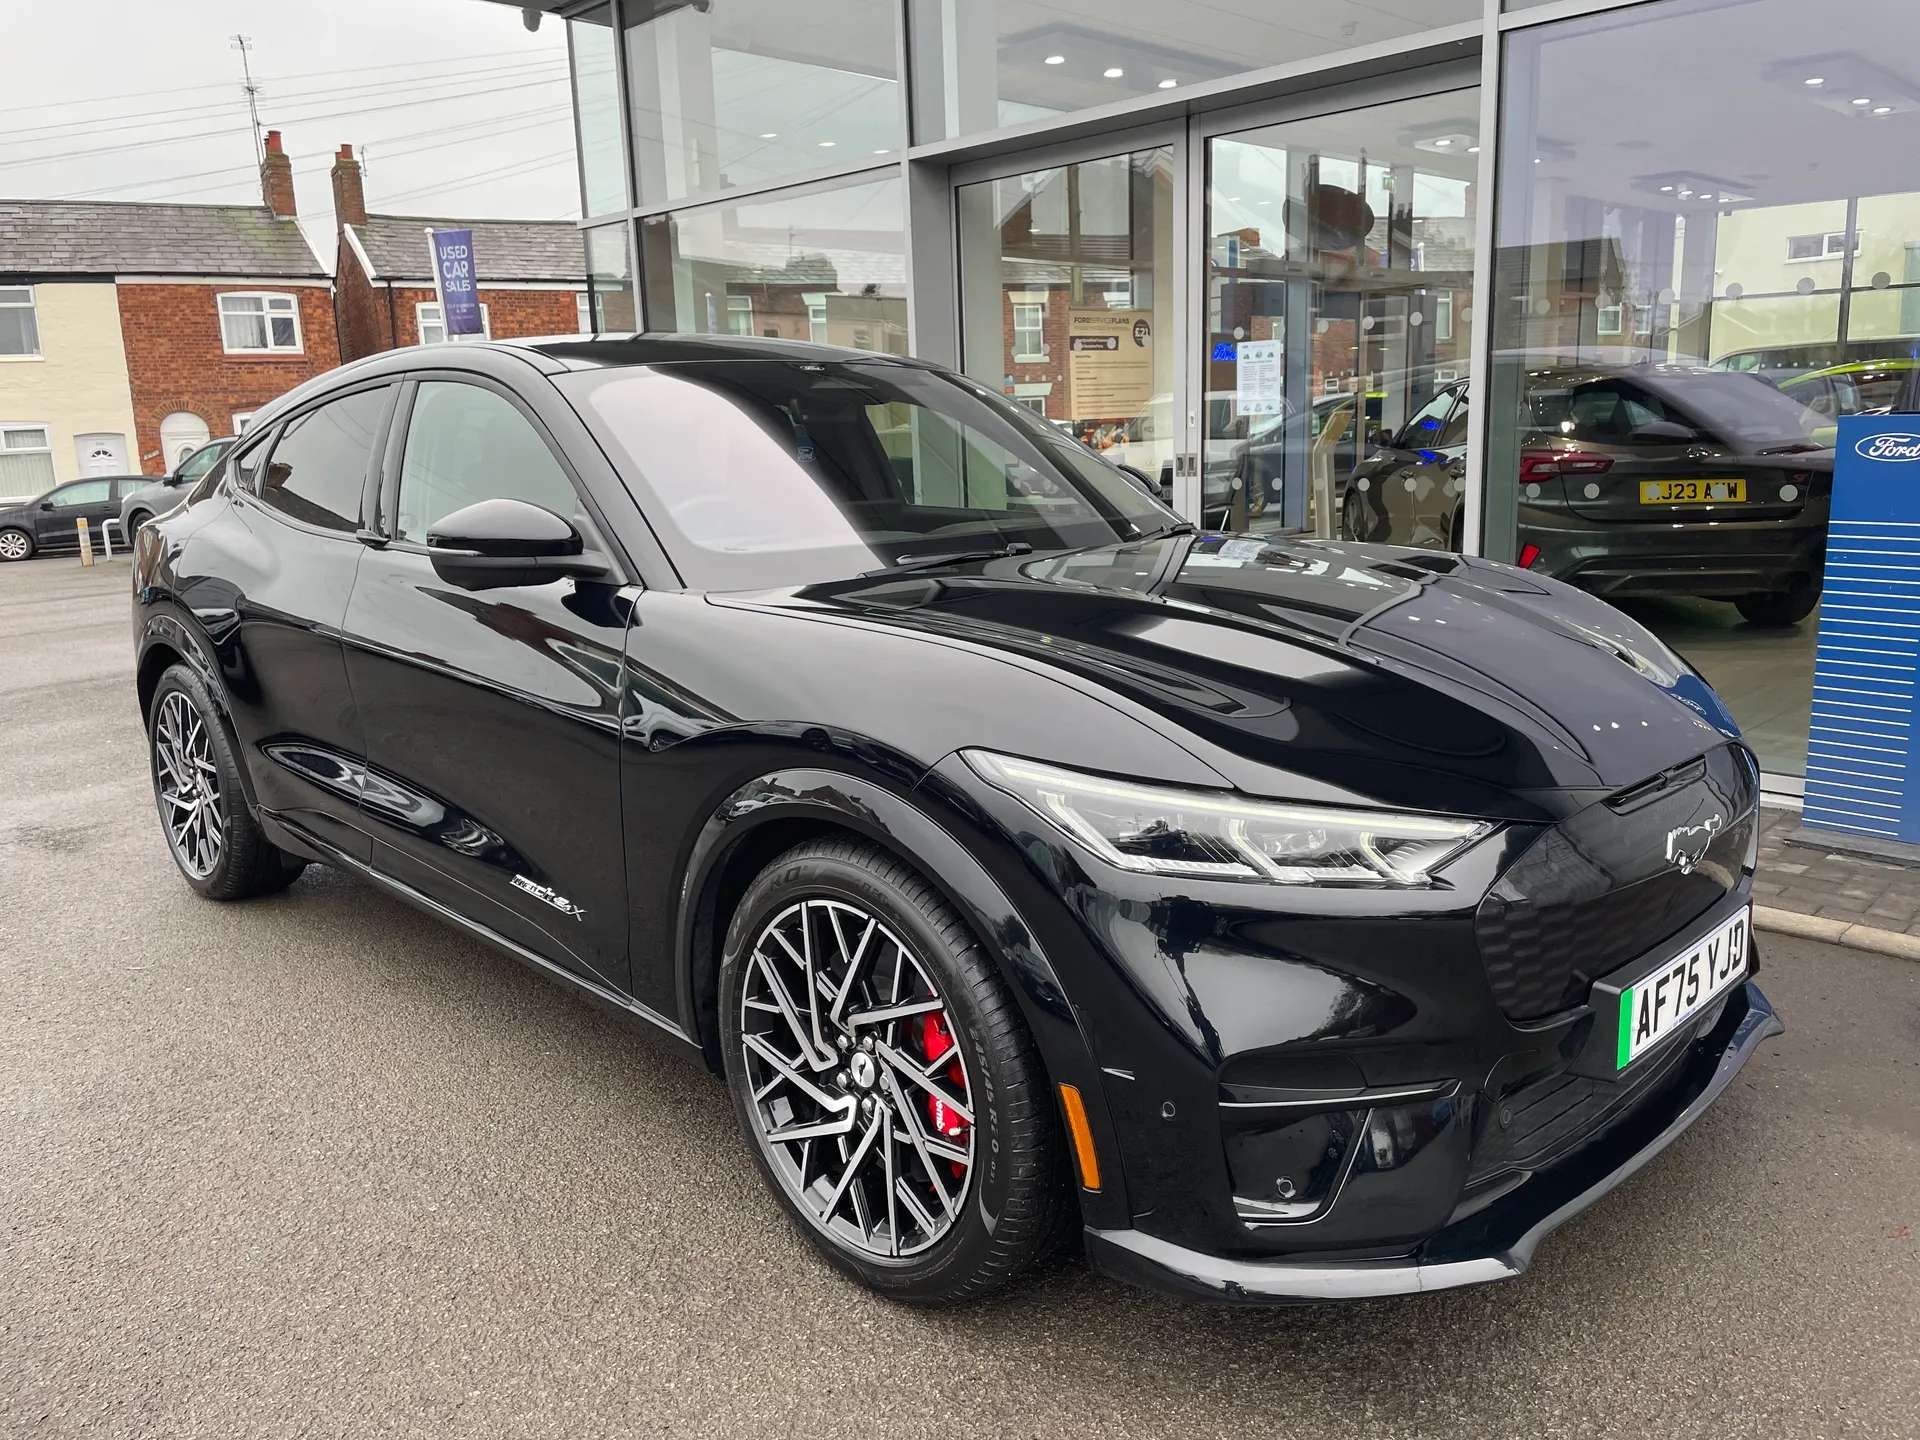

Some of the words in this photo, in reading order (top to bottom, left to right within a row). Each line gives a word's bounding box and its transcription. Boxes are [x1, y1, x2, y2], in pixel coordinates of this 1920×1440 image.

[439, 245, 468, 260] USED
[443, 260, 469, 278] CAR
[445, 279, 471, 292] SALES
[1868, 436, 1920, 457] Ford
[1647, 483, 1698, 500] J23
[1703, 482, 1738, 499] AW
[1636, 953, 1700, 1046] AF75
[1708, 919, 1744, 990] YJD
